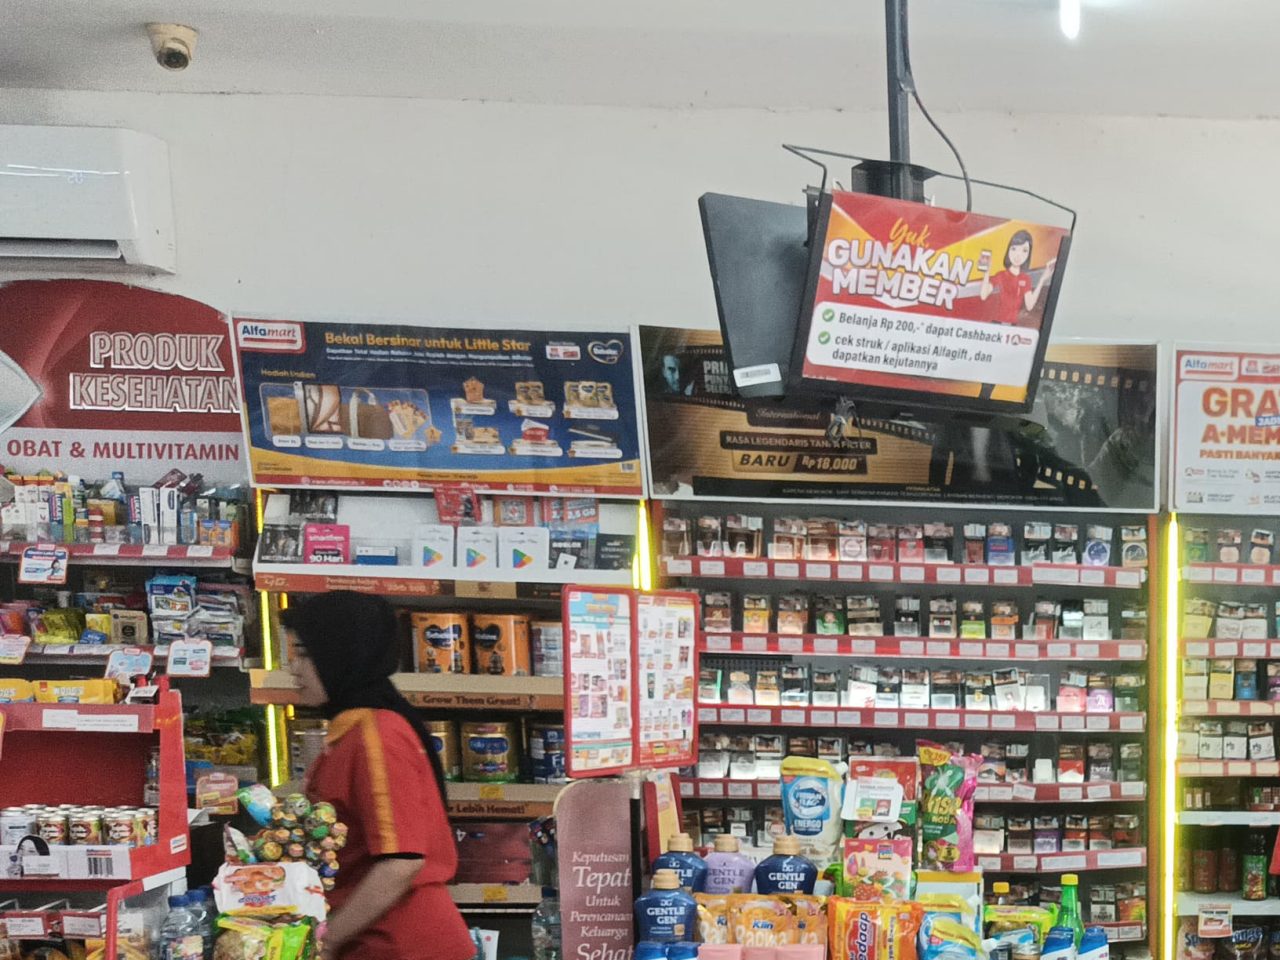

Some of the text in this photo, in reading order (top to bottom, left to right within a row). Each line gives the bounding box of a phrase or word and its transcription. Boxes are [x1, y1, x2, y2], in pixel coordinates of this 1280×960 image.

[889, 217, 932, 250] Yuk,
[828, 239, 973, 286] GUNAKAN
[831, 267, 961, 311] MEMBER
[242, 325, 297, 338] Alfamart
[839, 313, 878, 328] Belanja
[880, 317, 894, 331] Rp
[925, 323, 954, 340] dapat
[955, 327, 1003, 344] Cashback
[325, 332, 531, 351] Bekal Bersinar untuk Little Star
[90, 331, 226, 371] PRODUK
[835, 335, 855, 346] cek
[856, 337, 883, 350] struk
[891, 341, 931, 358] aplikasi
[974, 351, 992, 364] dan
[832, 349, 939, 372] dapatkan kejutannya
[1185, 359, 1233, 371] Alfamart
[70, 372, 241, 414] KESEHATAN
[726, 435, 750, 446] RASA
[751, 436, 809, 448] LEGENDARIS
[811, 439, 841, 449] TANA
[7, 439, 240, 462] OBAT & MULTIVITAMIN
[1200, 449, 1233, 460] PASTI
[740, 454, 791, 467] BARU
[309, 554, 323, 563] 90
[423, 696, 452, 705] Grow
[571, 851, 631, 866] Keputusan
[571, 866, 632, 893] Tepat
[713, 876, 735, 885] GEN
[768, 872, 806, 882] GENTLE
[778, 881, 798, 891] GEN
[585, 895, 621, 908] Untuk
[647, 906, 686, 917] GENTLE
[656, 916, 678, 925] GEN
[580, 926, 629, 940] Keluarga
